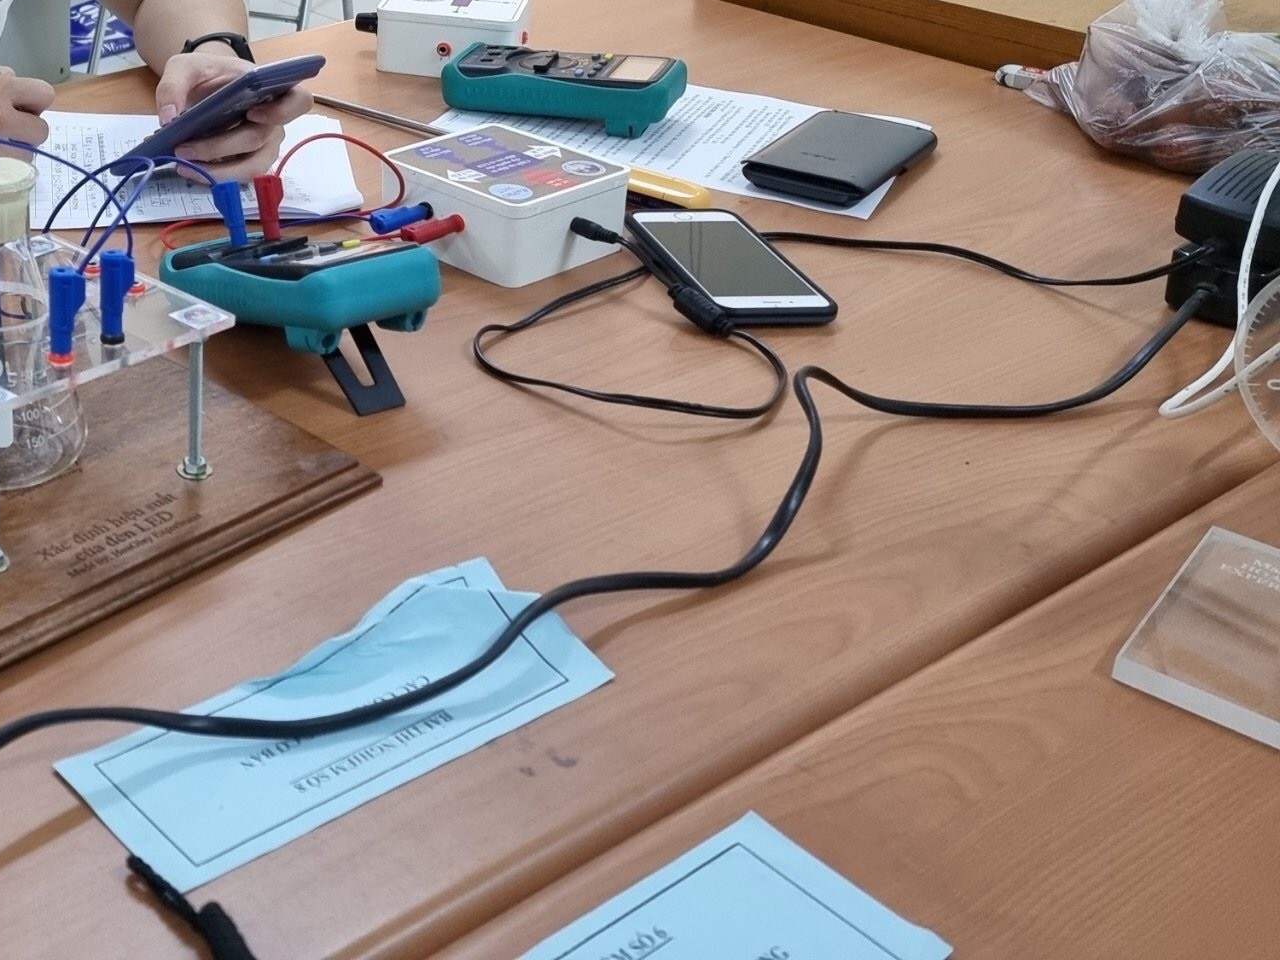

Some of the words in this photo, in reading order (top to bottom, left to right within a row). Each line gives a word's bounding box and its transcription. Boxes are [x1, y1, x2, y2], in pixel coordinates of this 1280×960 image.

[20, 409, 40, 423] 100
[25, 436, 44, 449] 150
[133, 510, 174, 533] LED
[652, 925, 668, 939] 6
